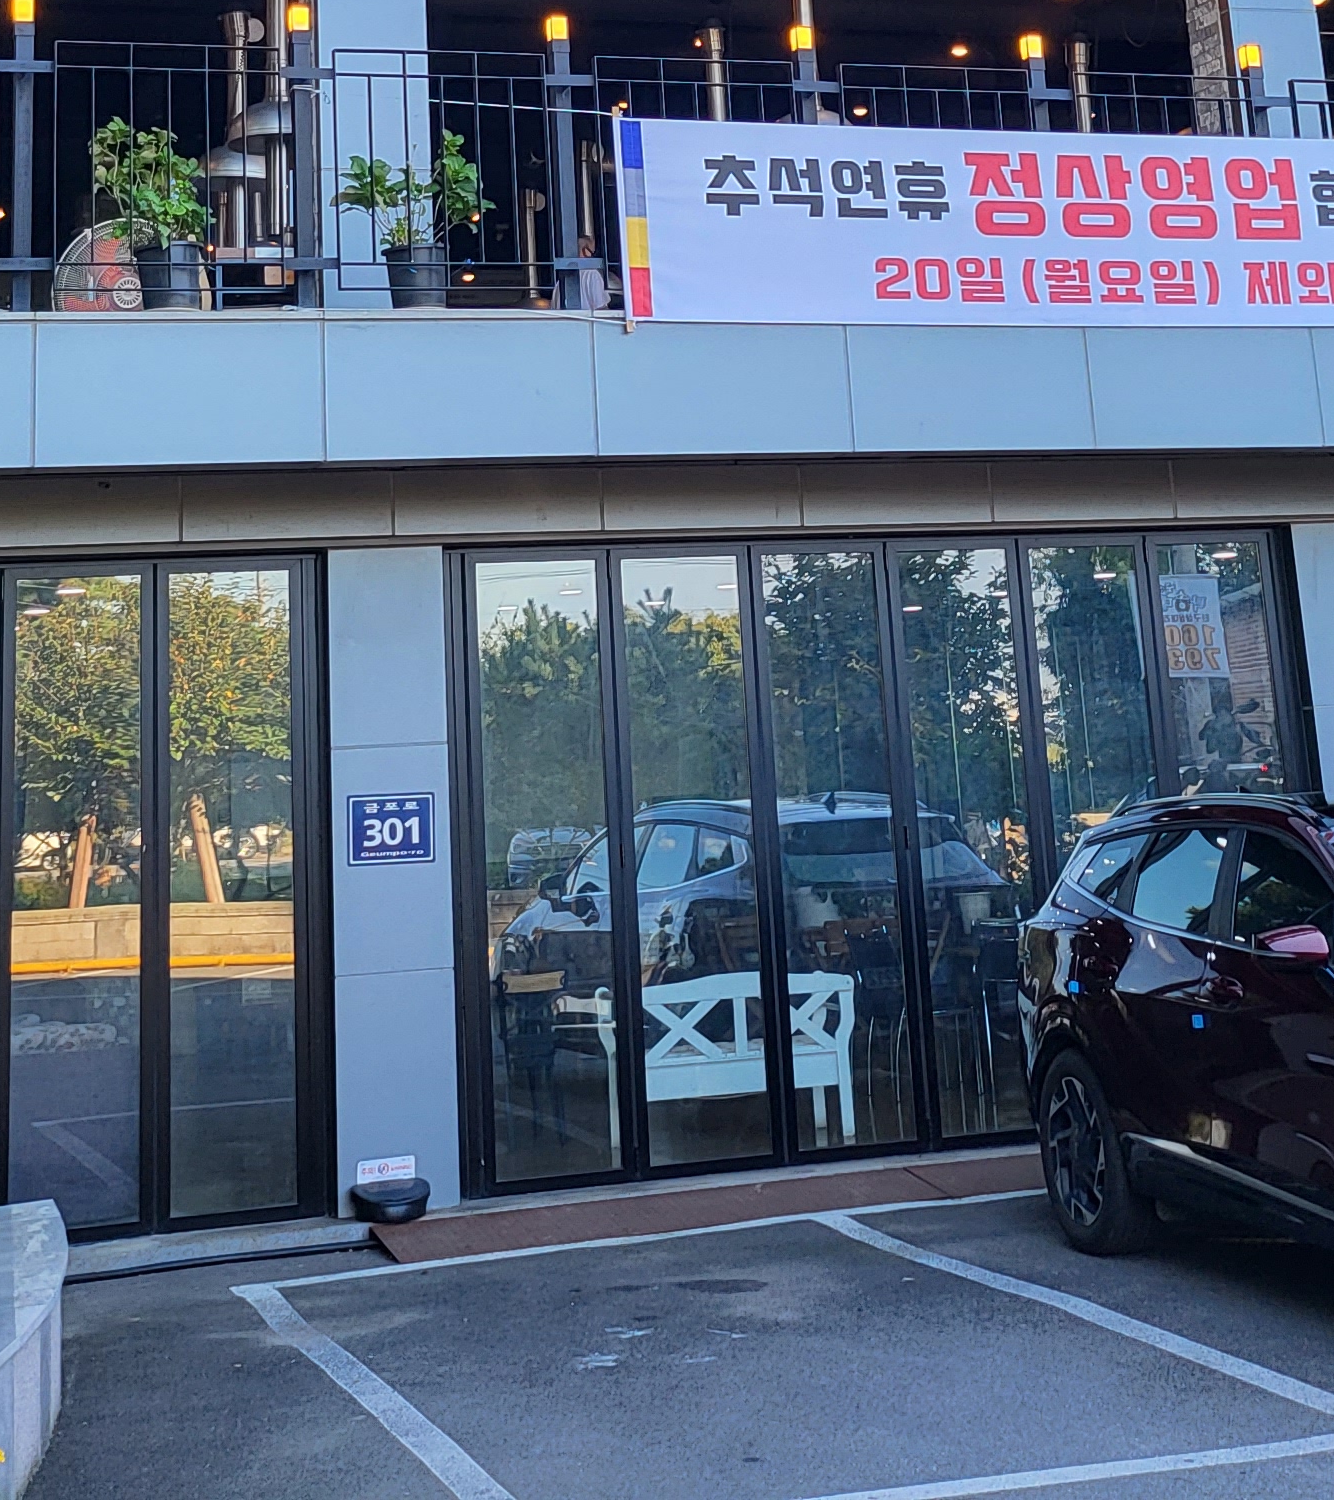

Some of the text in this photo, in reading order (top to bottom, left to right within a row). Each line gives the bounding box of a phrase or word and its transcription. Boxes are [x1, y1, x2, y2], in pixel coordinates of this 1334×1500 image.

[703, 154, 951, 221] 추석연휴
[363, 801, 420, 814] 금포로
[363, 816, 420, 847] 301
